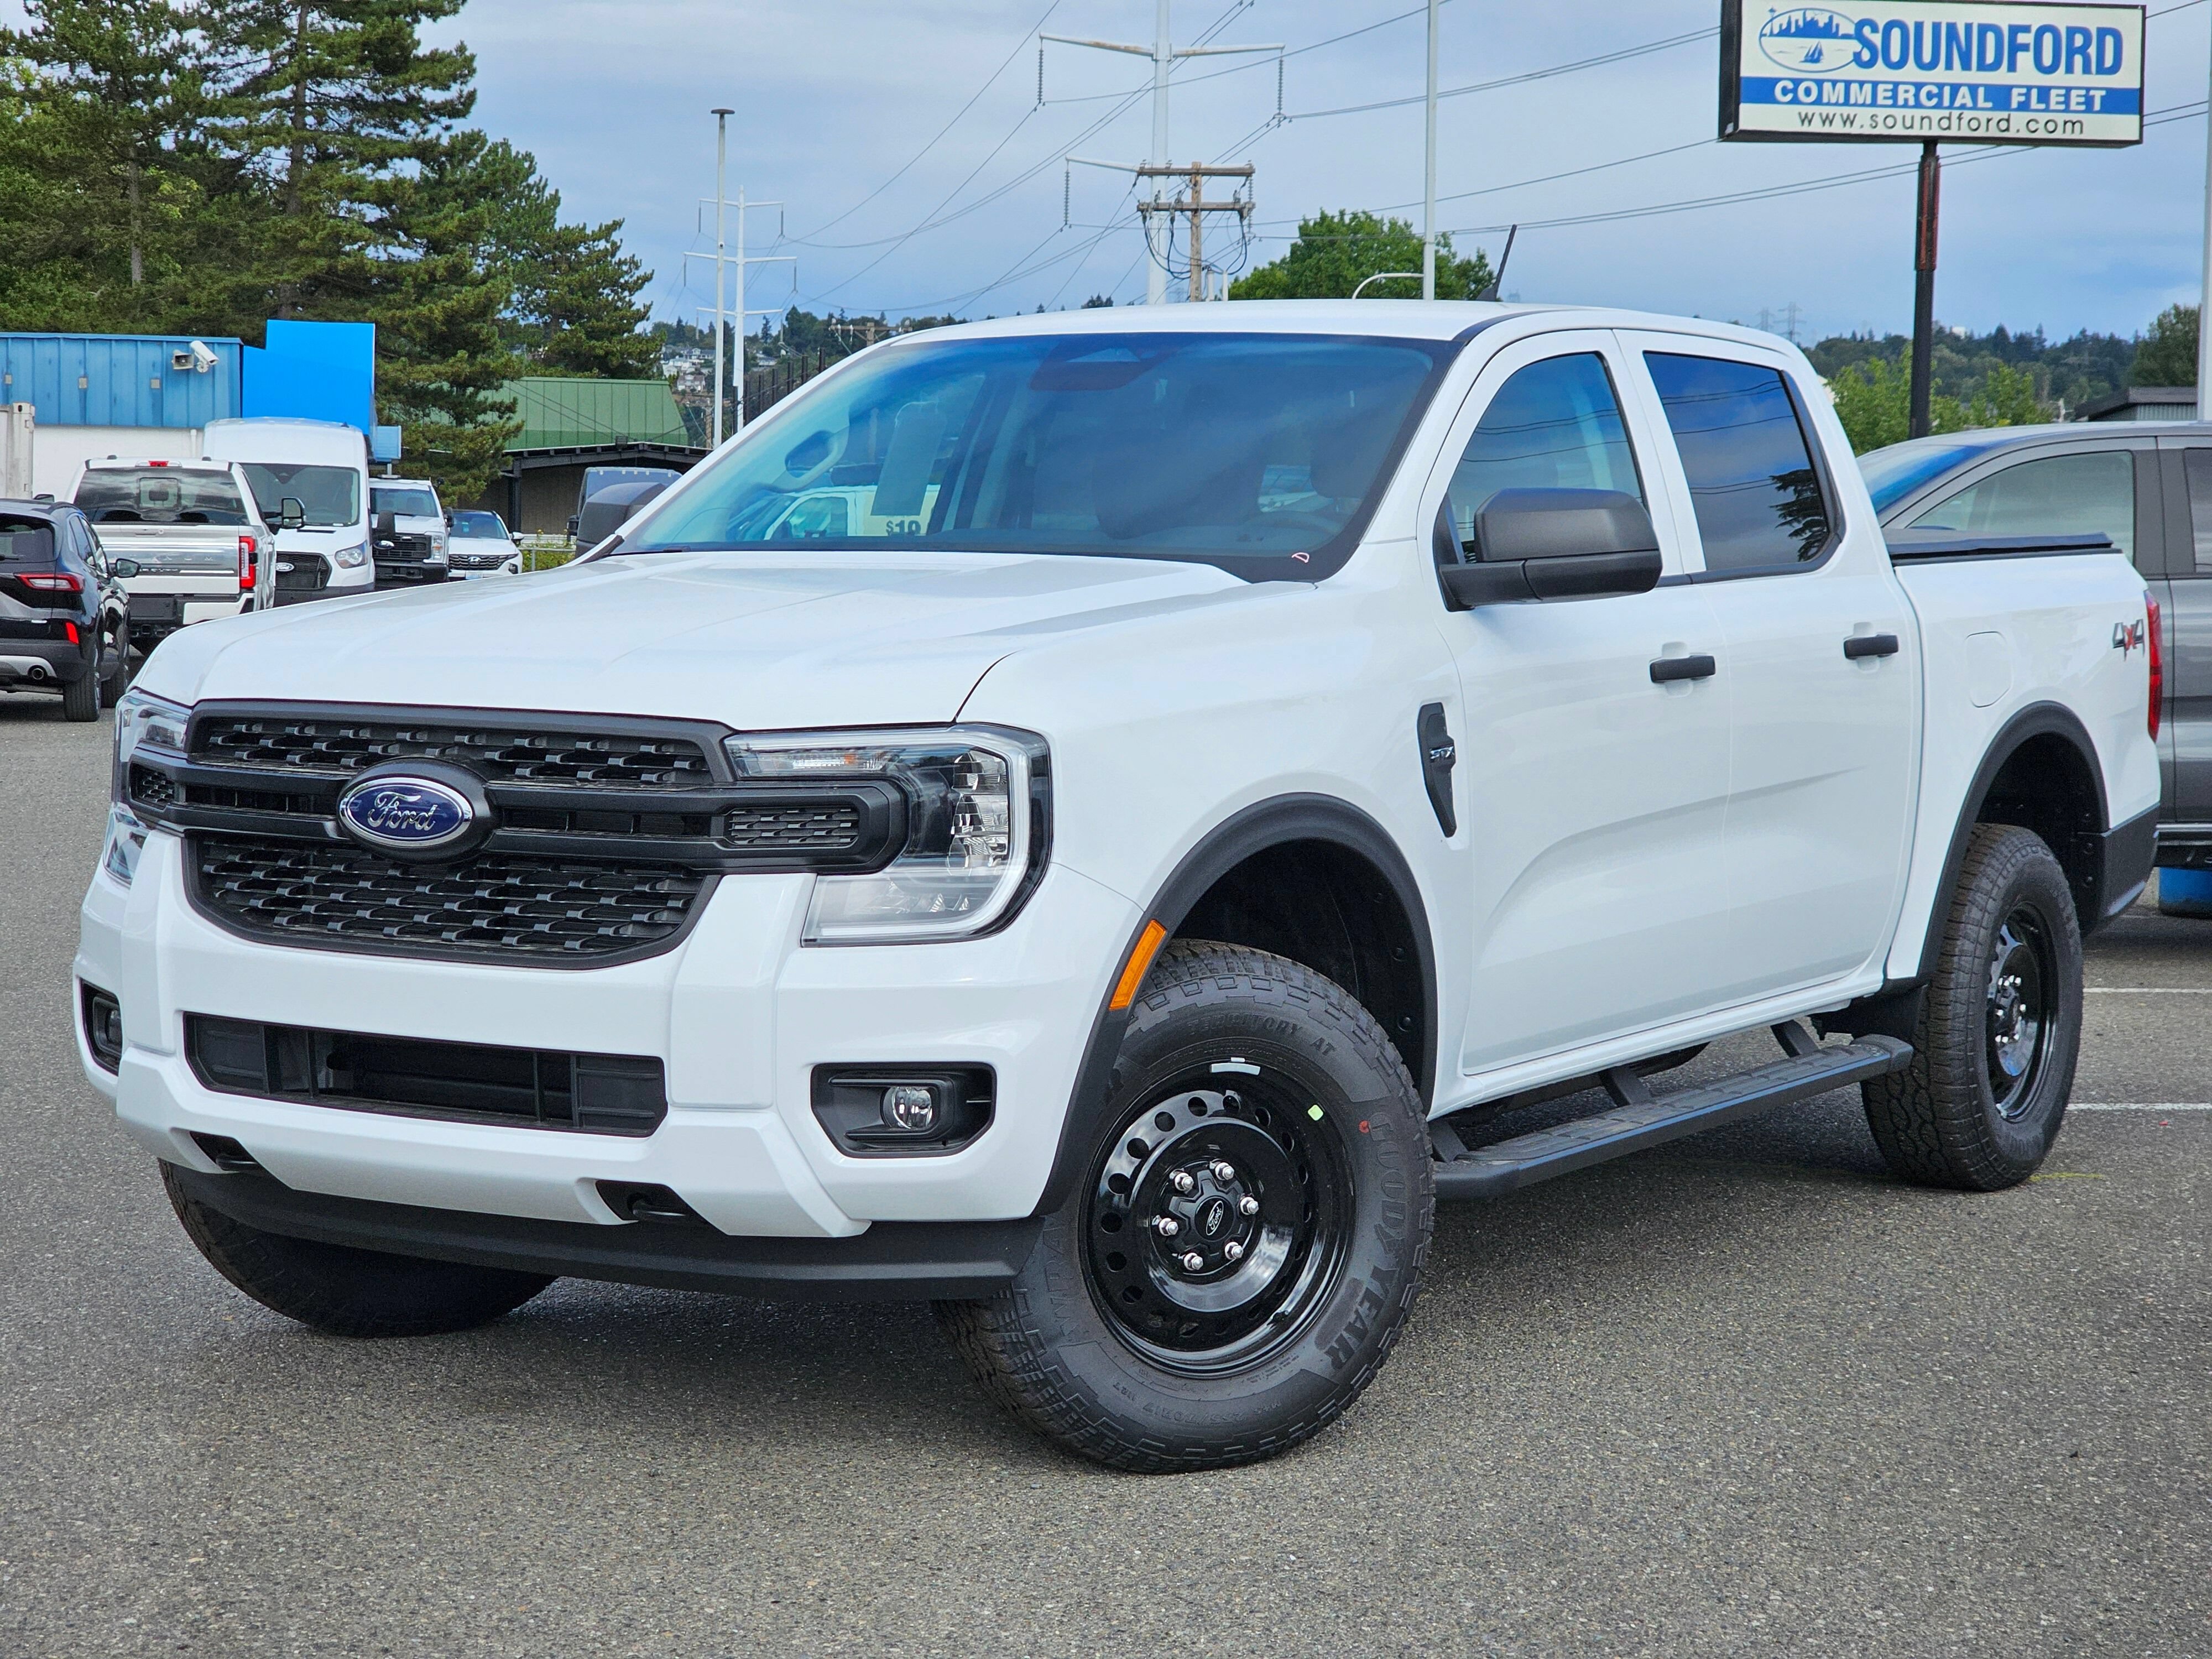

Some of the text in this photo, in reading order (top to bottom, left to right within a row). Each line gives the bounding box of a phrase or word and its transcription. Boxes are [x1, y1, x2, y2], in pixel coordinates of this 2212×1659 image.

[1853, 17, 2124, 76] SOUNDFORD
[1774, 80, 2106, 112] COMMERCIAL FLEET
[1798, 111, 2084, 135] www.soundford.com
[367, 791, 439, 832] Ford
[1310, 1036, 1337, 1056] AT
[1208, 1206, 1222, 1230] Ford
